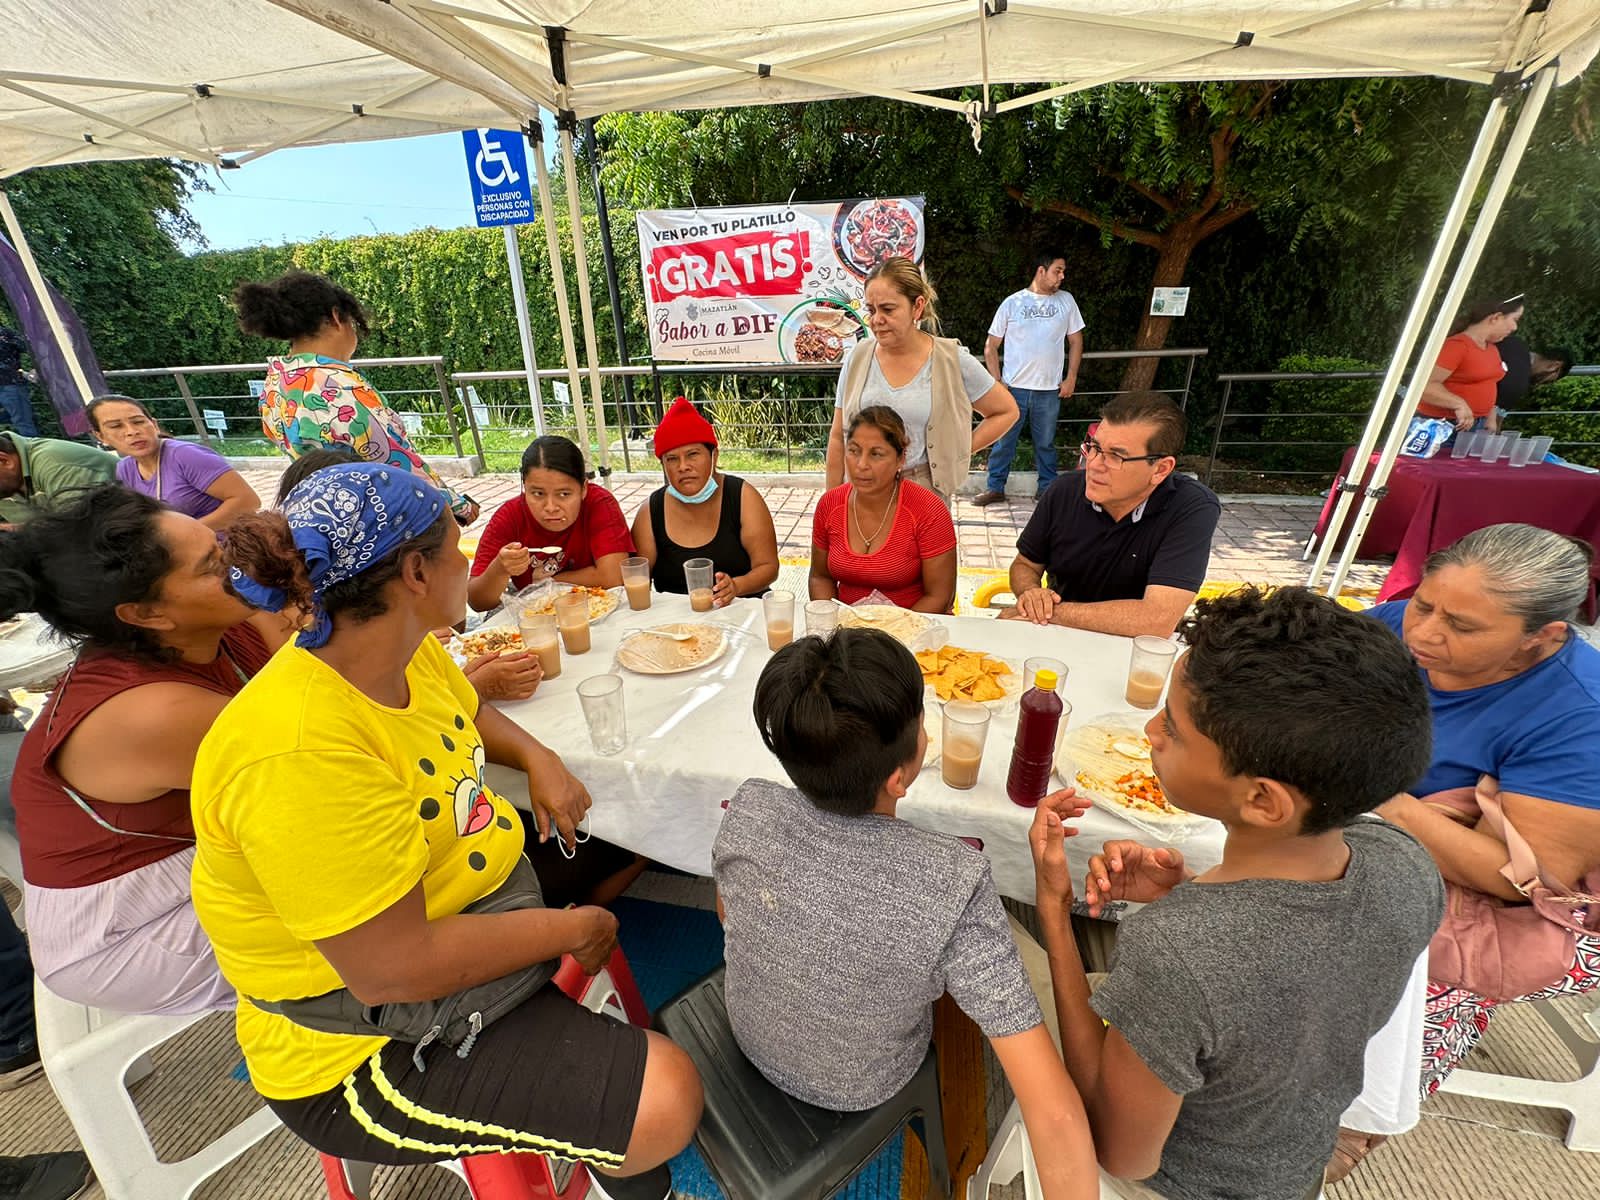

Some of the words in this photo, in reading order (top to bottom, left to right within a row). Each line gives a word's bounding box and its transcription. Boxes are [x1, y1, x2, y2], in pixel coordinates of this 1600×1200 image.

[482, 191, 521, 203] EXCLUSIVO
[477, 202, 513, 212] PERSONAS
[514, 200, 530, 208] CON
[481, 209, 529, 221] DISCAPACIDAD
[653, 230, 679, 241] VEN
[680, 225, 708, 239] POR
[711, 222, 728, 234] TU
[731, 211, 796, 231] PLATILLO
[701, 304, 737, 314] MAZATLÁN
[659, 319, 709, 343] Sabor
[716, 323, 728, 336] a
[733, 313, 777, 336] DIF
[692, 348, 717, 357] Cocina
